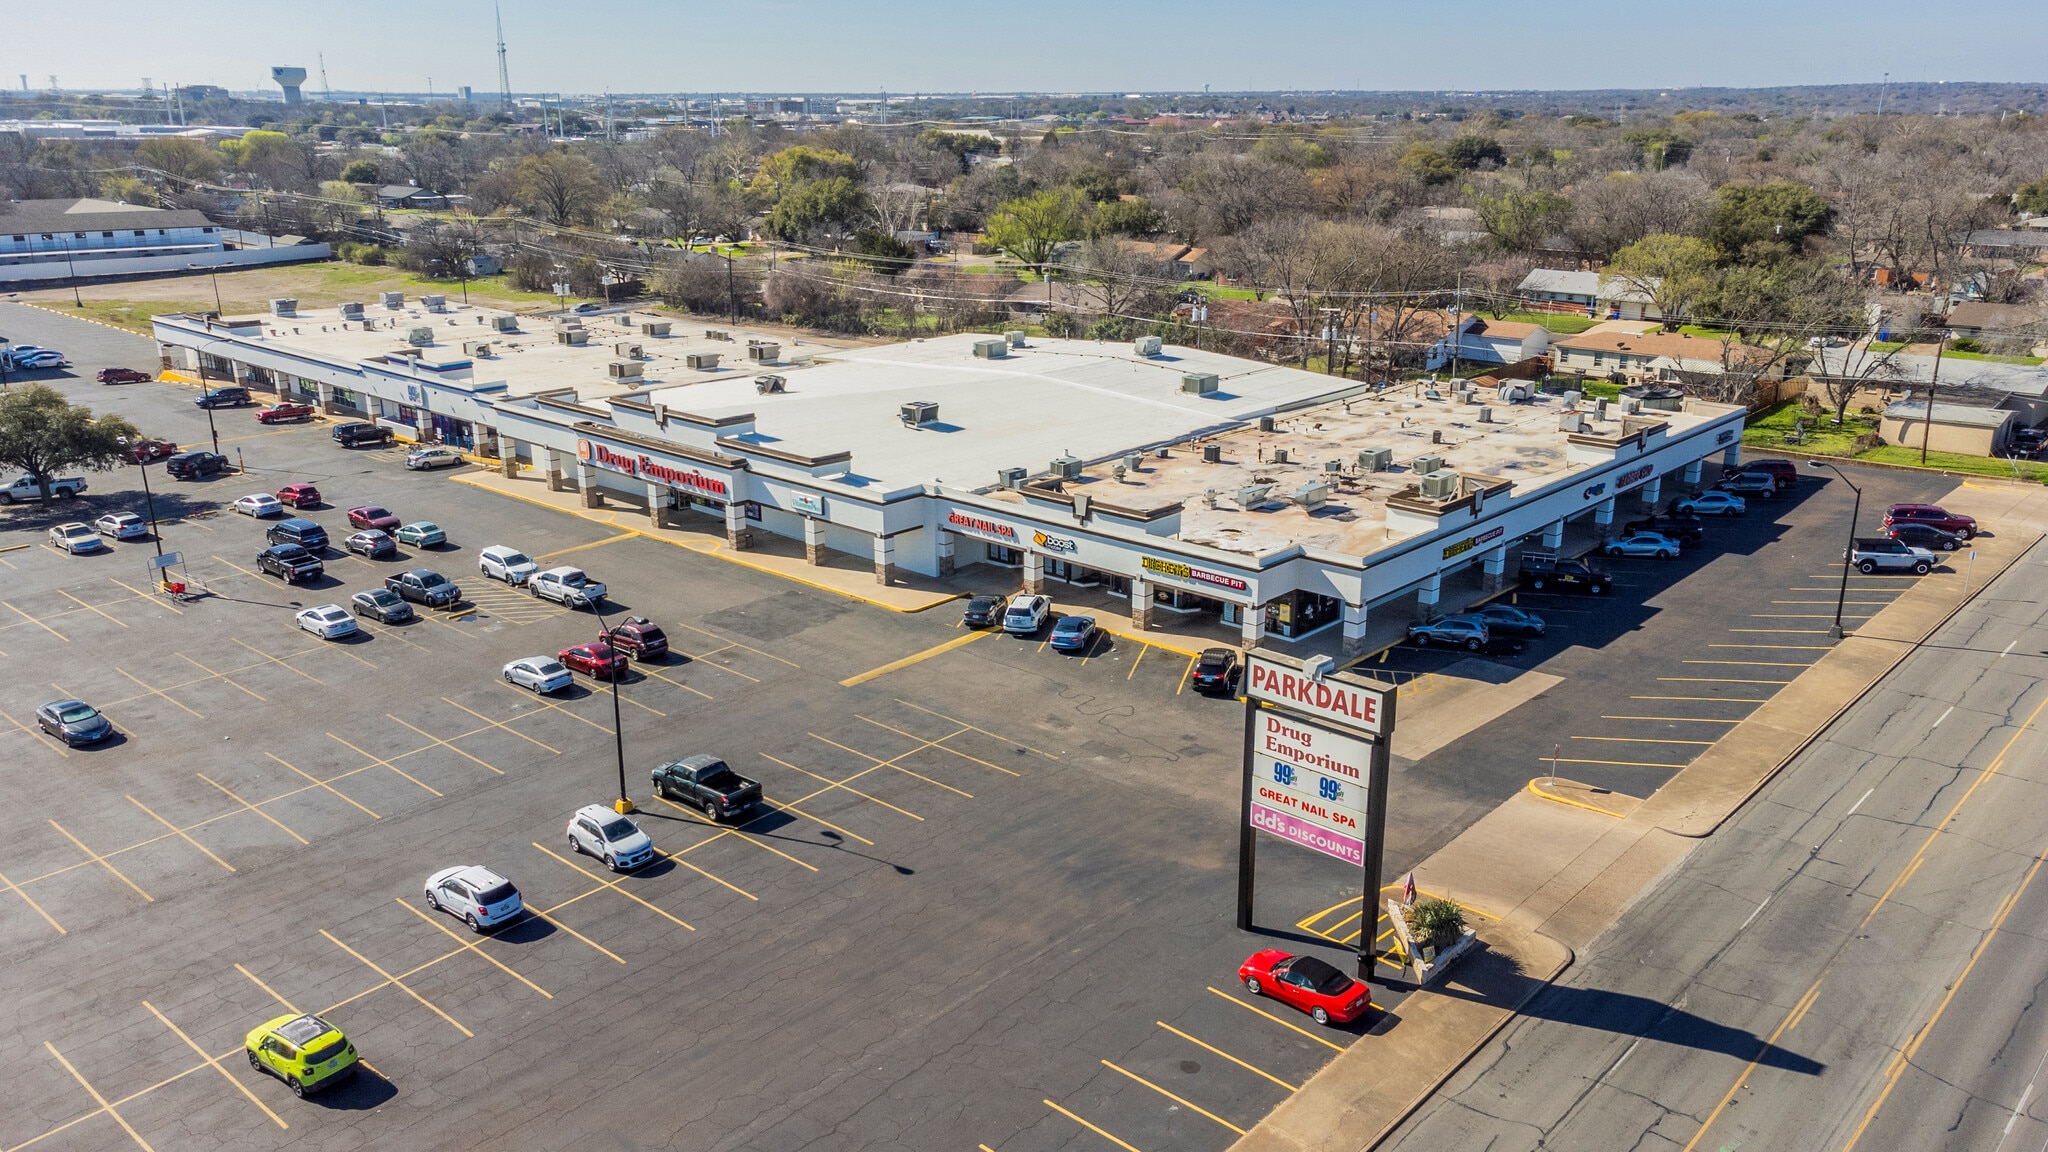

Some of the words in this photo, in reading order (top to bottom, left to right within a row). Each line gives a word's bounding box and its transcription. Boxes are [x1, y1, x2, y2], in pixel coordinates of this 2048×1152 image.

[595, 444, 636, 475] Drug
[638, 454, 725, 495] Emporium
[948, 512, 975, 528] GREAT
[974, 519, 996, 534] NAIL
[995, 525, 1014, 537] SPA
[1047, 535, 1075, 550] boost
[1142, 556, 1191, 579] DICKEY'S
[1191, 570, 1230, 585] BARBECUE
[1230, 579, 1243, 588] PIT
[1252, 664, 1377, 723] PARKDALE
[1266, 716, 1312, 747] Drug
[1265, 735, 1360, 779] Emporium
[1259, 787, 1298, 808] GREAT
[1302, 802, 1329, 819] NAIL
[1333, 813, 1357, 829] SPA
[1254, 809, 1286, 833] dd's
[1288, 827, 1361, 861] DISCOUNTS
